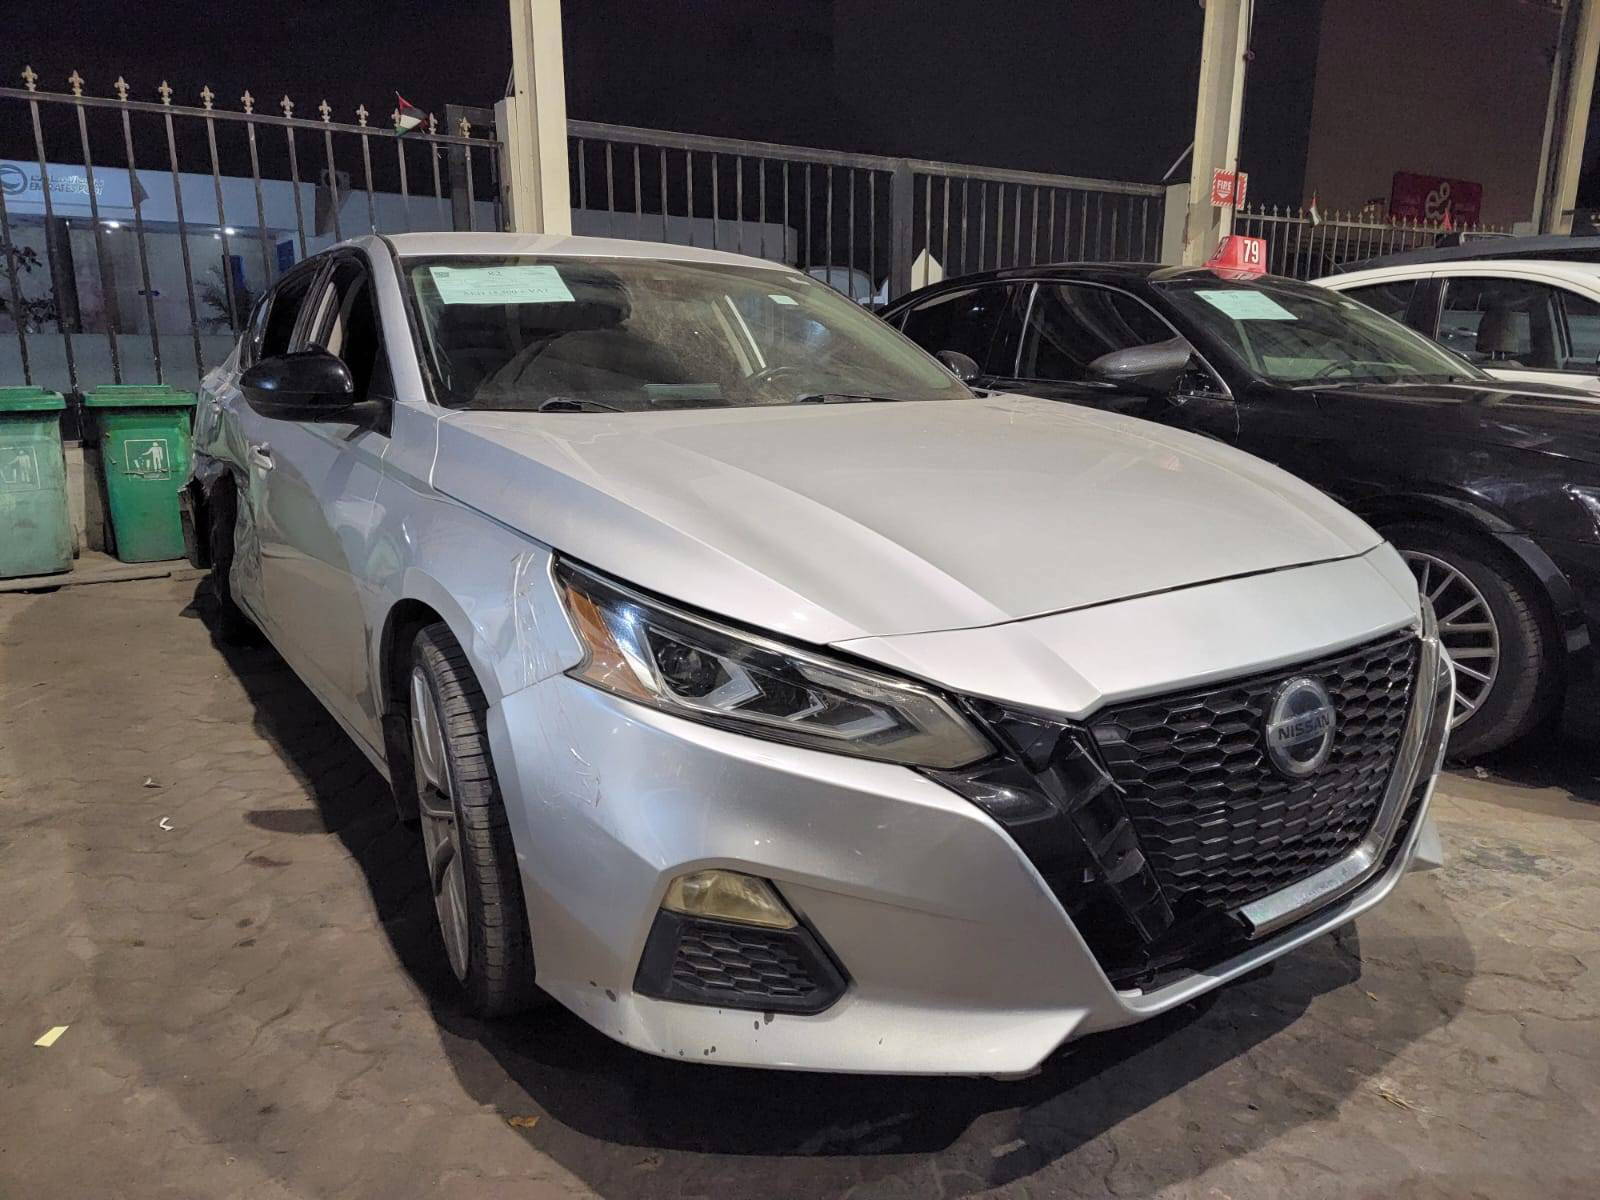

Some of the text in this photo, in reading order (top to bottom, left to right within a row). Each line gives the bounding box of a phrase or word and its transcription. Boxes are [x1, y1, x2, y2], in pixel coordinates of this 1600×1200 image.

[29, 182, 76, 193] EMRATES
[1216, 179, 1232, 191] FIRE
[1243, 239, 1259, 263] 79
[1278, 713, 1330, 740] NISSAN
